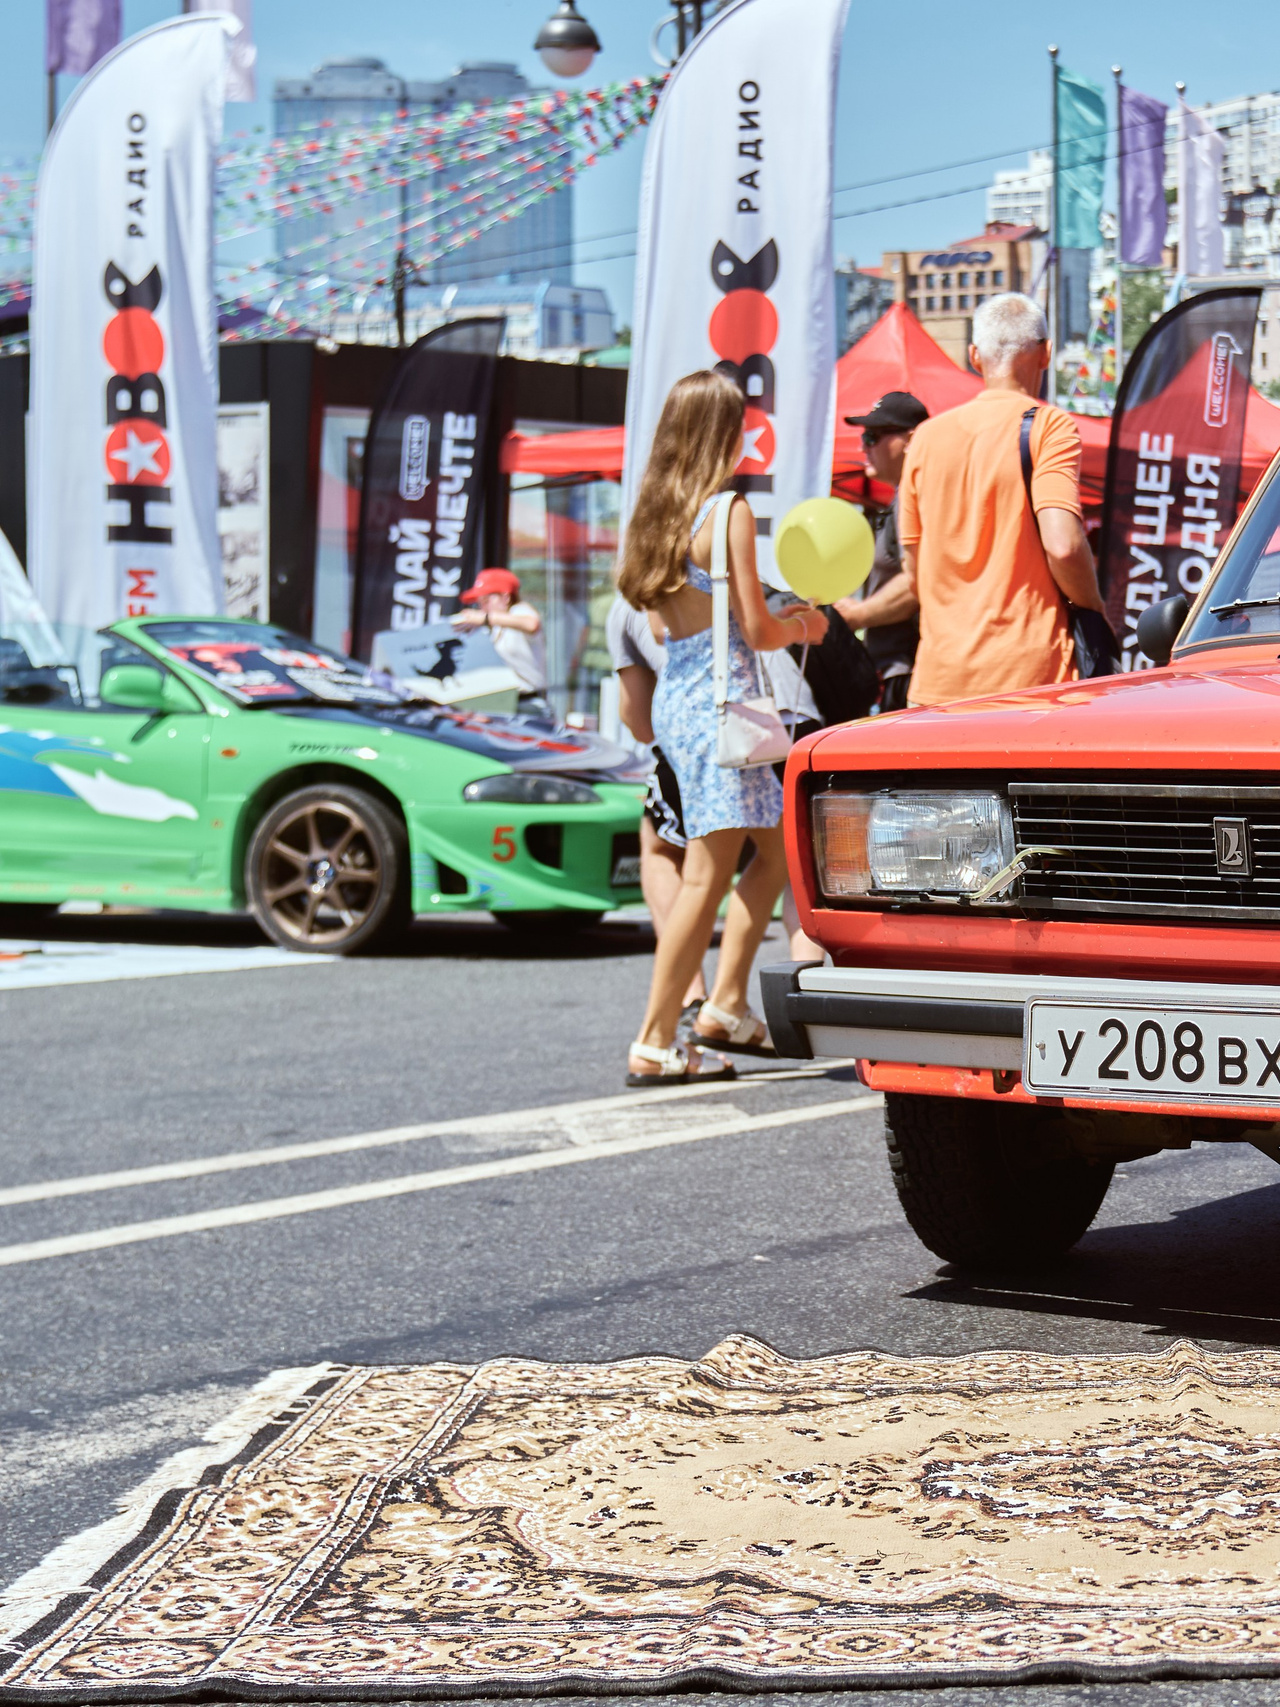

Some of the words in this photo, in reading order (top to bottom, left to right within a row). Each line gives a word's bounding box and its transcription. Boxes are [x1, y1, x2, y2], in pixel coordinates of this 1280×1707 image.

[127, 112, 147, 239] РАДИО
[737, 80, 764, 215] РАДИО
[434, 411, 478, 559] МЕЧТЕ
[430, 565, 463, 598] К
[492, 825, 517, 863] 5
